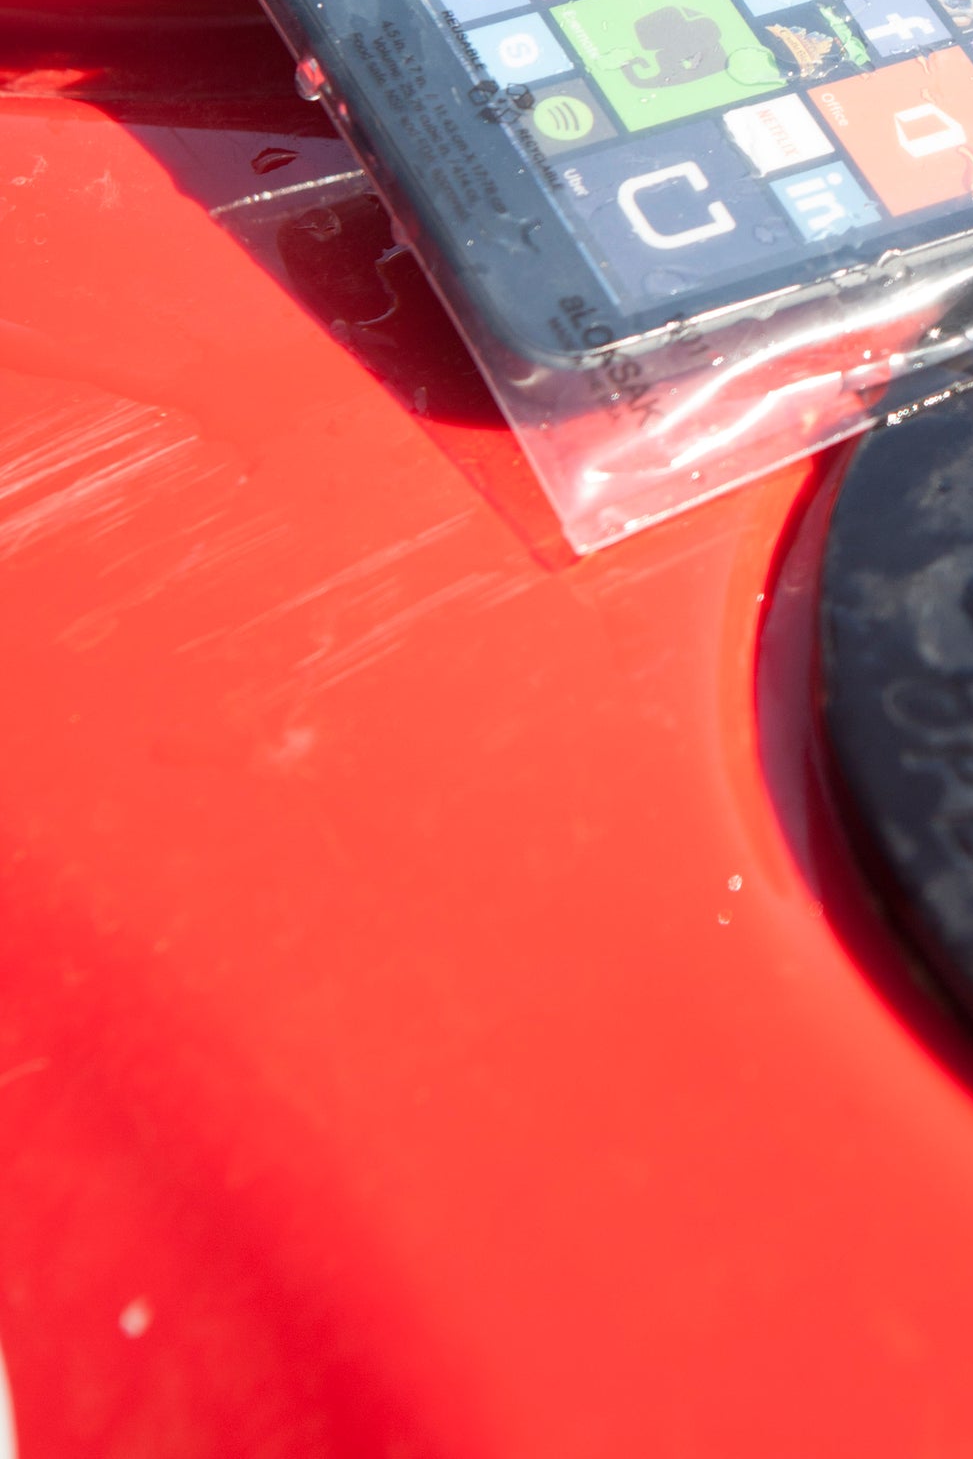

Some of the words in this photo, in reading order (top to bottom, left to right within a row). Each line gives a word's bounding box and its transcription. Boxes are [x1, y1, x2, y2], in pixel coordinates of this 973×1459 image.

[441, 11, 486, 69] REUSABLE
[561, 10, 601, 58] Evernote
[756, 108, 799, 156] NETFLIX
[820, 92, 850, 126] Office
[516, 128, 563, 190] RECYCLABLE
[560, 167, 591, 198] Uber
[785, 172, 850, 232] in
[561, 295, 666, 424] aLOKSAK
